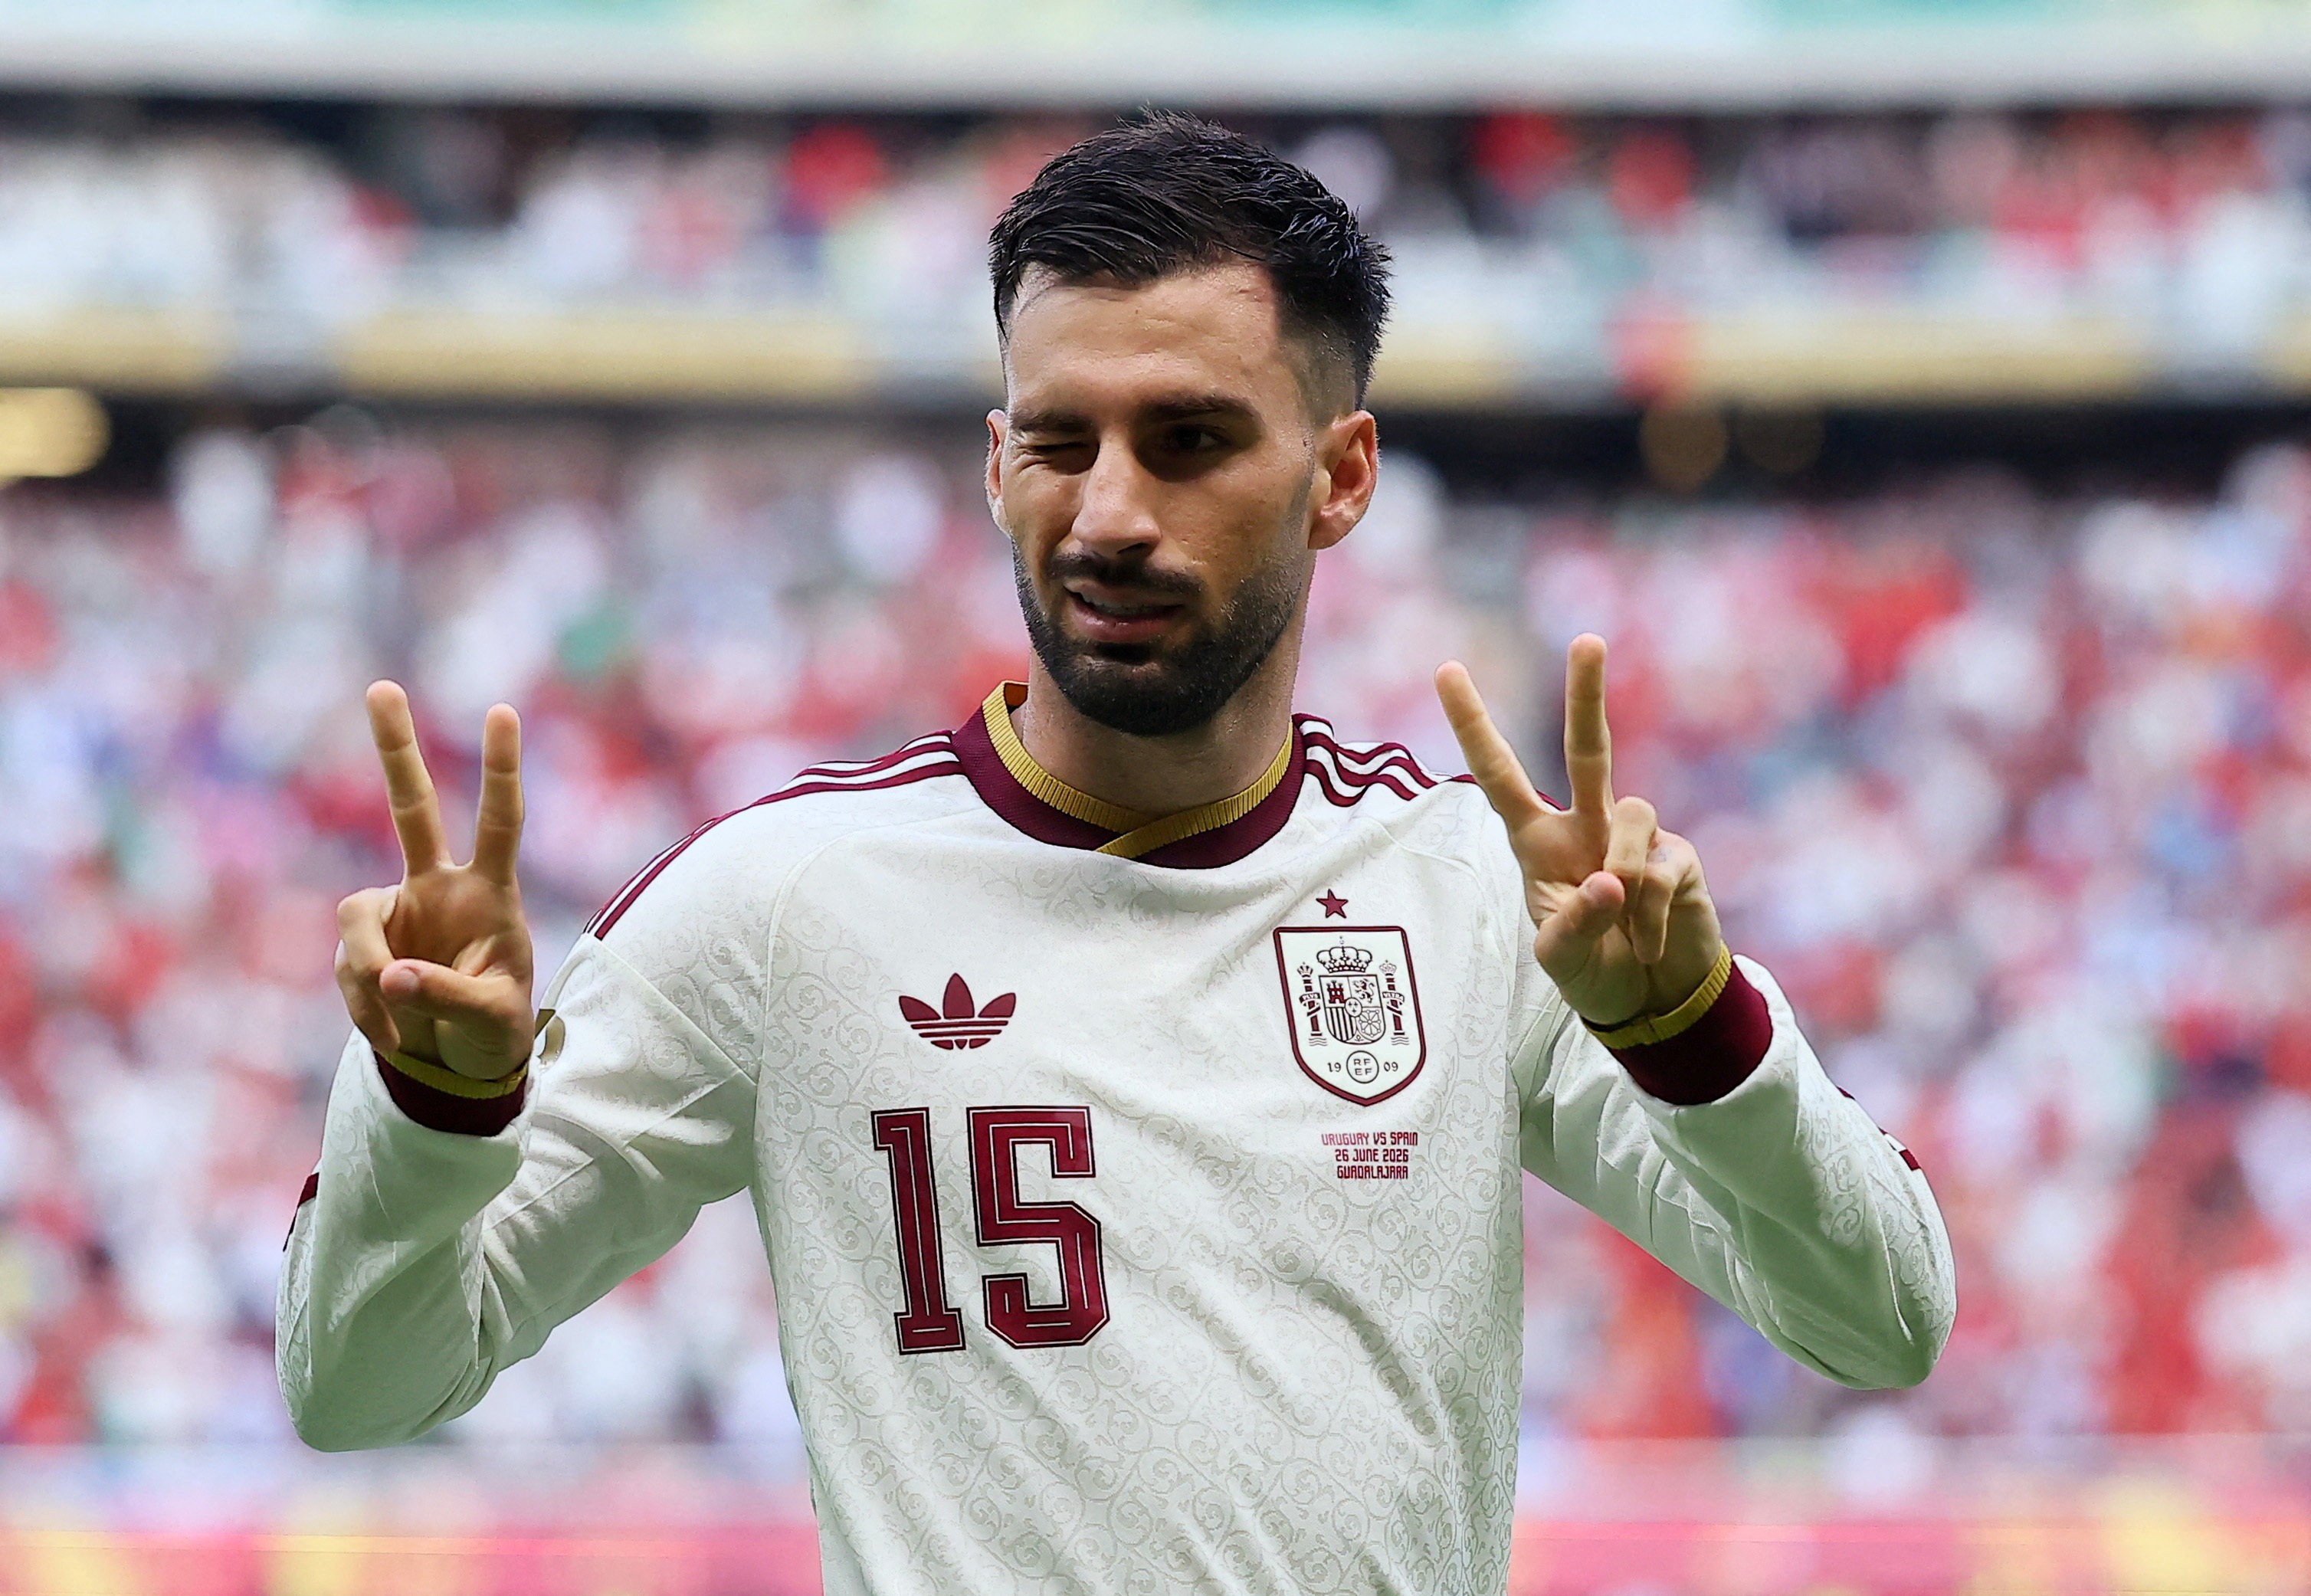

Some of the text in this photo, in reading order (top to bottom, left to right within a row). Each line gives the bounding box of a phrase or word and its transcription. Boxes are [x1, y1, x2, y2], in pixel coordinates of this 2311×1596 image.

[1327, 1062, 1342, 1073] 19
[1383, 1061, 1398, 1072] 09
[1321, 1132, 1418, 1145] URUGUAY VS SPAIN
[1335, 1149, 1409, 1162] 26 JUNE 2026
[1337, 1165, 1408, 1179] GUADALAJARA
[870, 1106, 1110, 1355] 15
